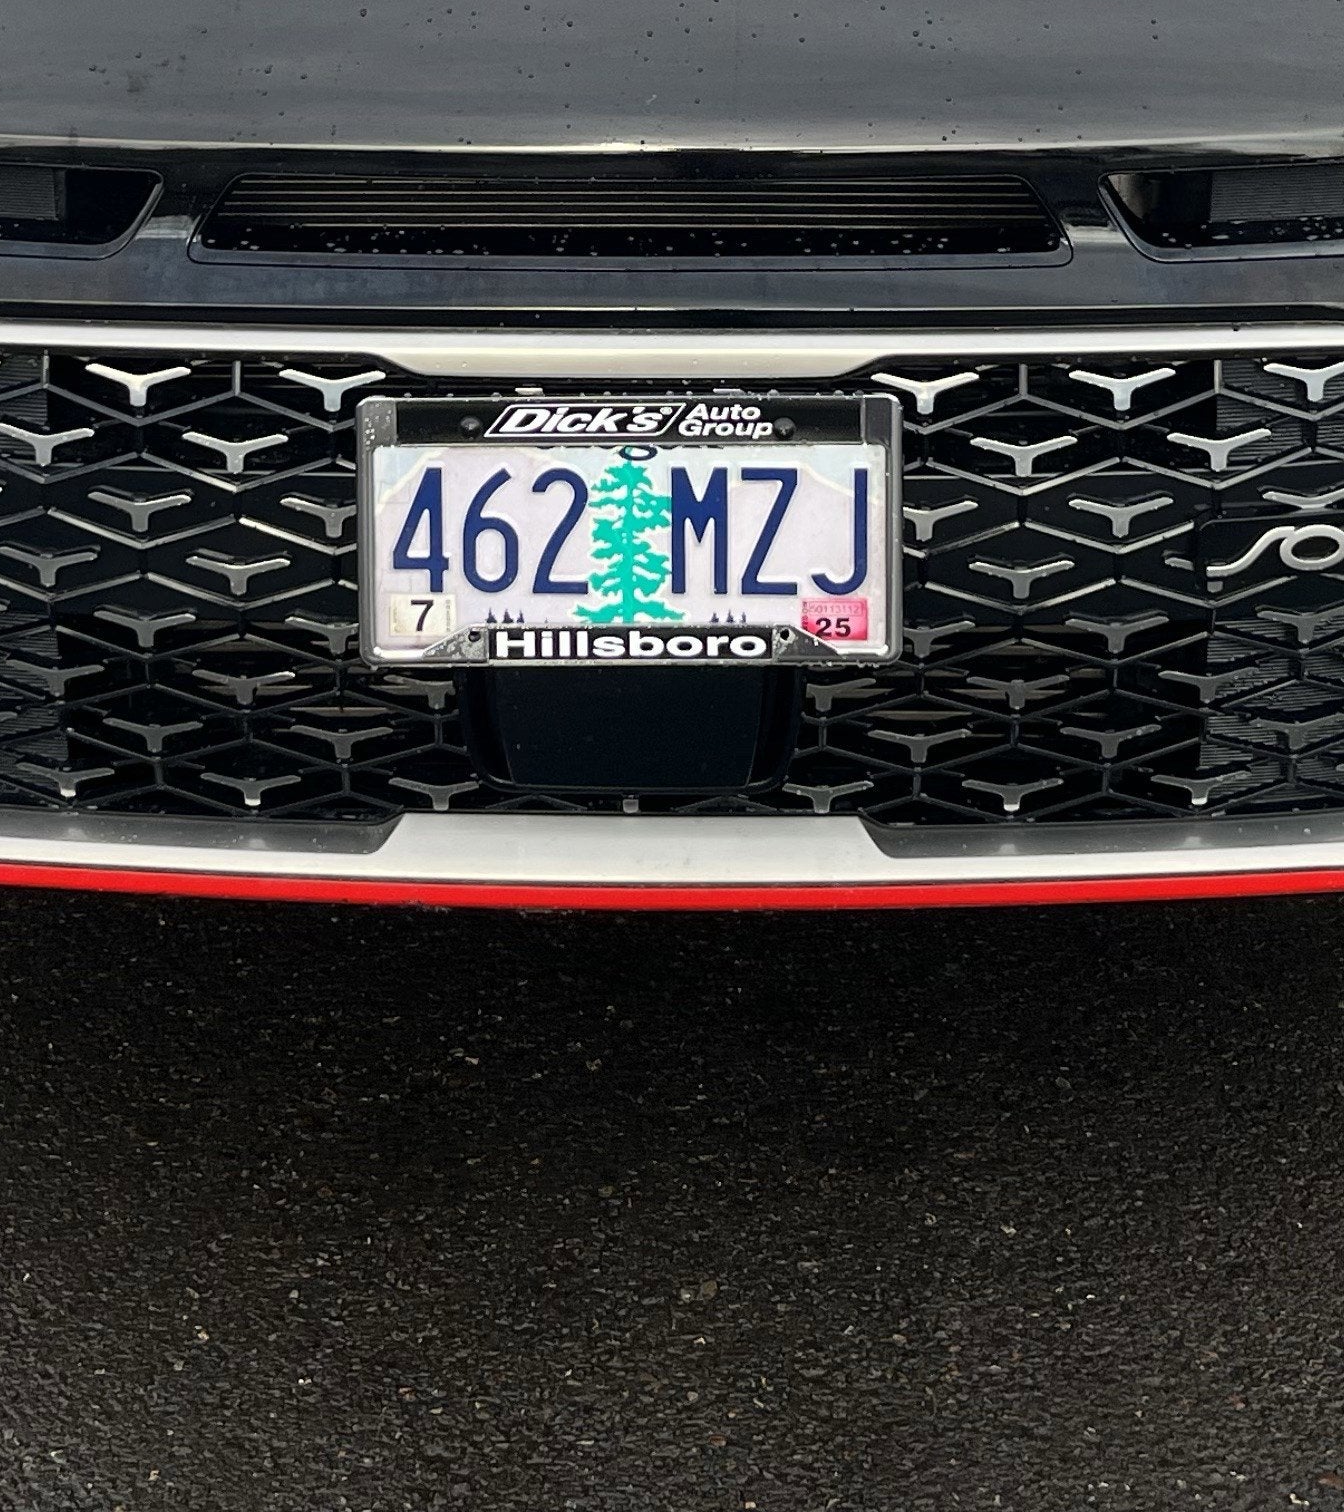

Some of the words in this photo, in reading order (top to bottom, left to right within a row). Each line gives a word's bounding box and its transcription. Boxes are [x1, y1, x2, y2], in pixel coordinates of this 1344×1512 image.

[498, 406, 663, 433] Dick's
[685, 403, 761, 421] Auto
[678, 419, 773, 439] Group
[392, 467, 589, 595] 462
[671, 467, 868, 595] MZJ
[410, 599, 434, 632] 7
[815, 617, 851, 637] 25
[495, 630, 767, 658] Hillsboro
